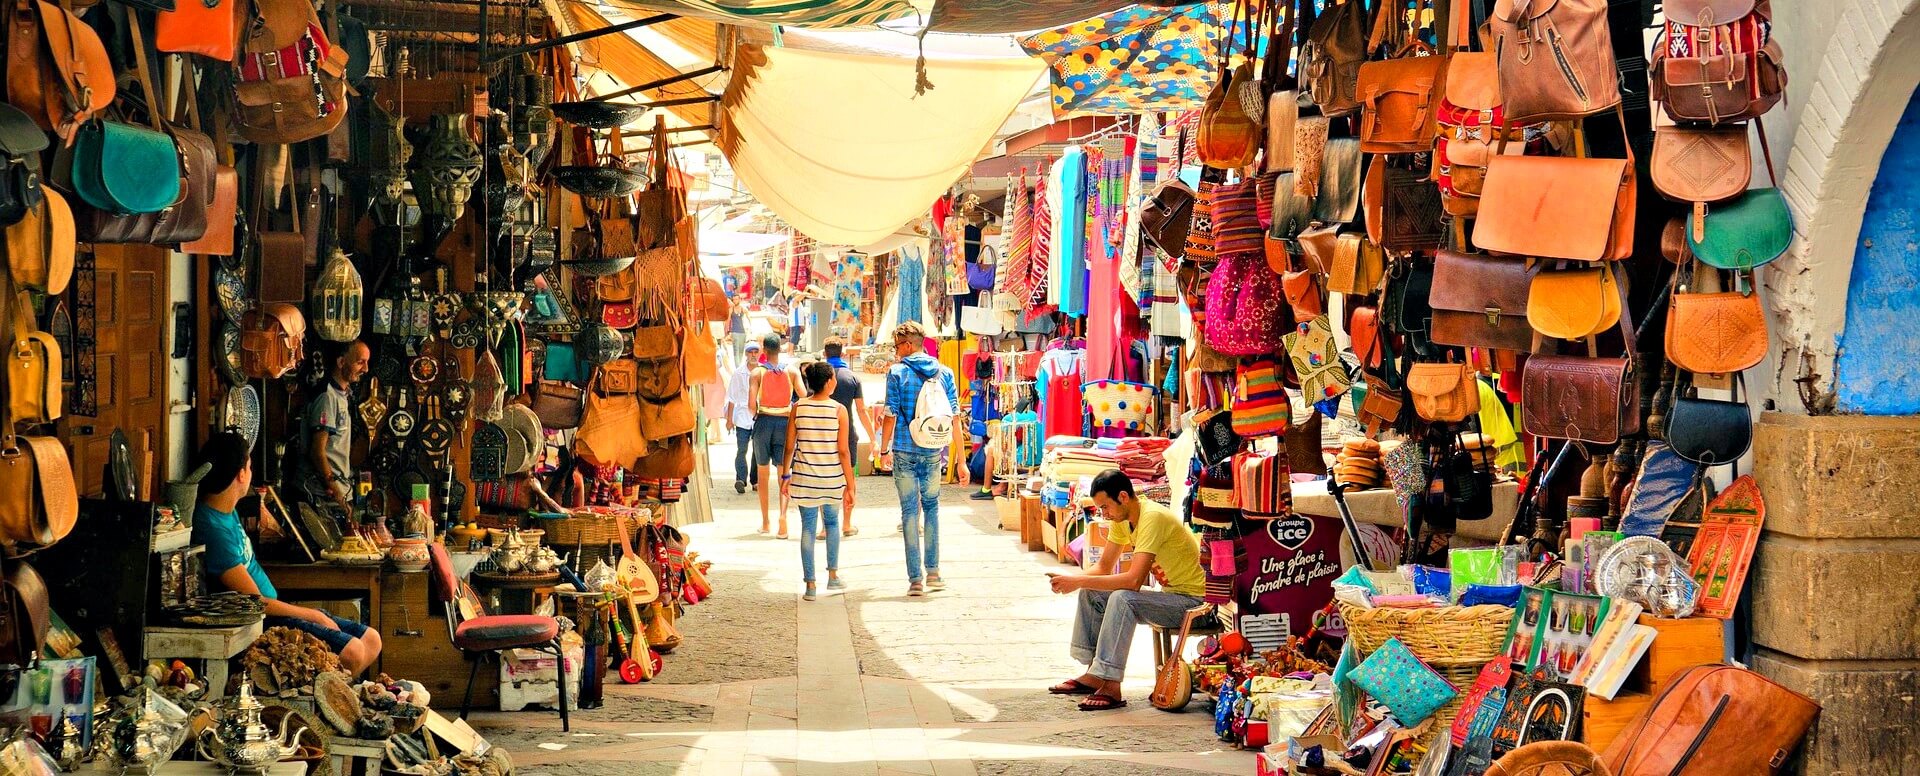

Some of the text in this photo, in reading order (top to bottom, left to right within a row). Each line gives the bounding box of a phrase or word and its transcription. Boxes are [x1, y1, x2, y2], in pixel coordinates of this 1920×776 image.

[1277, 519, 1305, 527] Groupe
[1277, 528, 1307, 540] ice
[1261, 549, 1325, 576] Une glace à
[1250, 561, 1339, 604] fondre de plaisir
